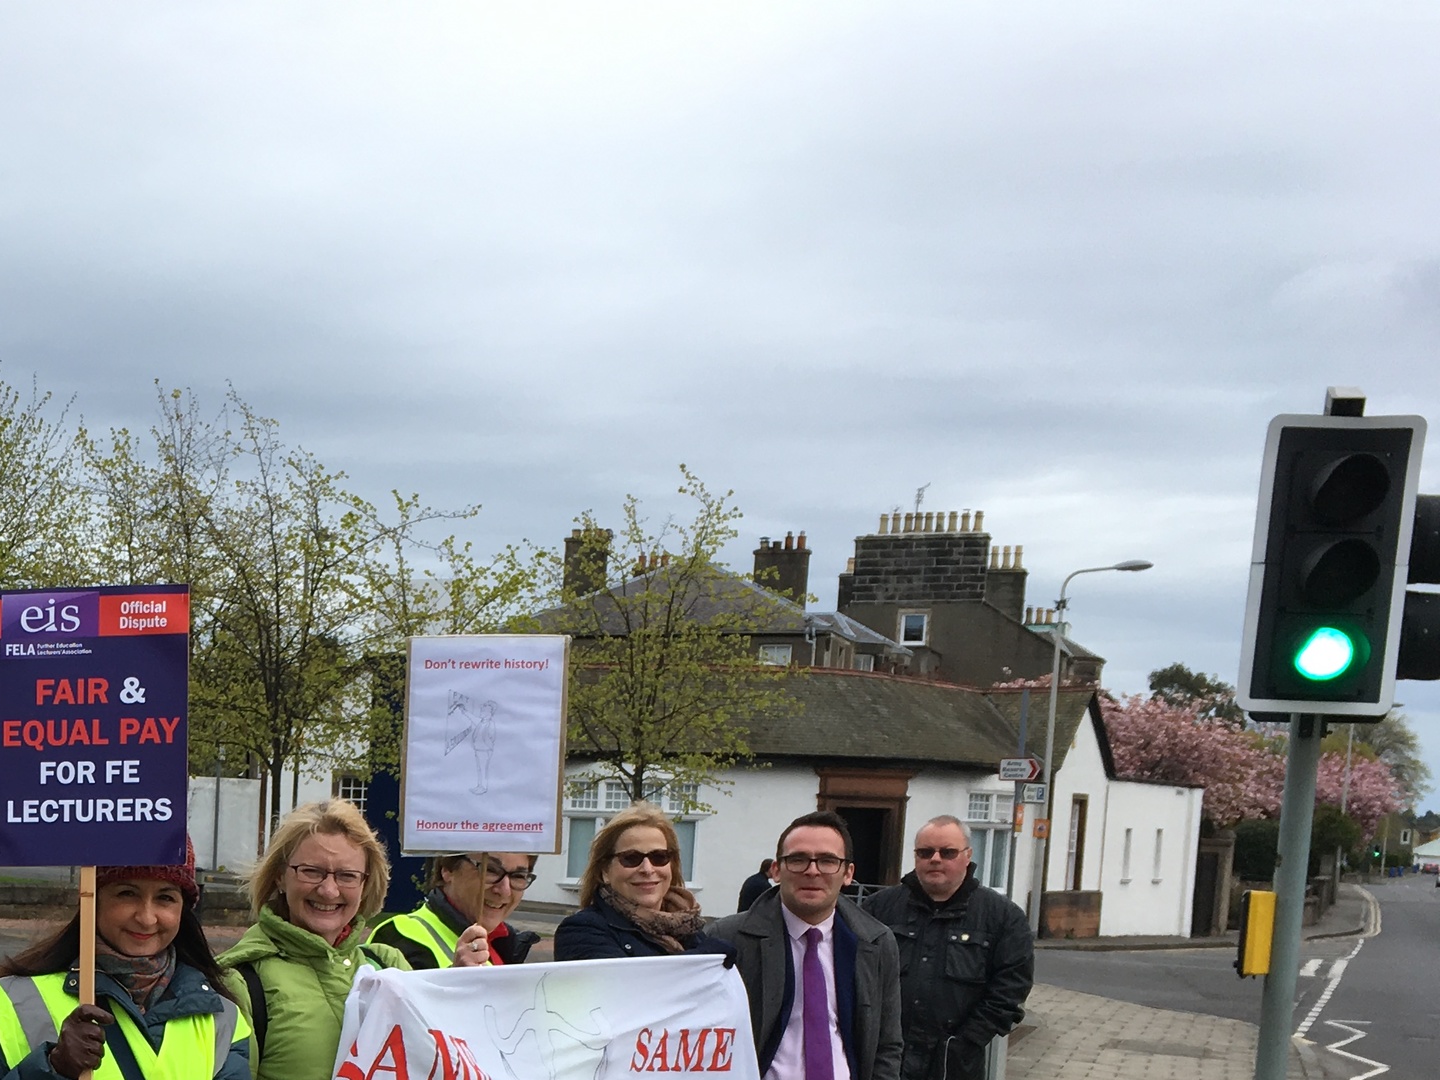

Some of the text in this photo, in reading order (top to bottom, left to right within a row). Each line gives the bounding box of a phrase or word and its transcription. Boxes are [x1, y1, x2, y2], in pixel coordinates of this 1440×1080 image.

[20, 599, 81, 633] eis
[120, 601, 166, 614] Official
[119, 615, 168, 631] Dispute
[6, 643, 36, 656] FELA
[424, 658, 549, 671] Don’t rewrite history!
[36, 676, 146, 706] FAIR &
[3, 717, 180, 750] EQUAL PAY
[40, 760, 140, 784] FOR FE
[7, 798, 173, 823] LECTURERS
[416, 819, 544, 832] Honour the agreement
[629, 1027, 736, 1072] SAME
